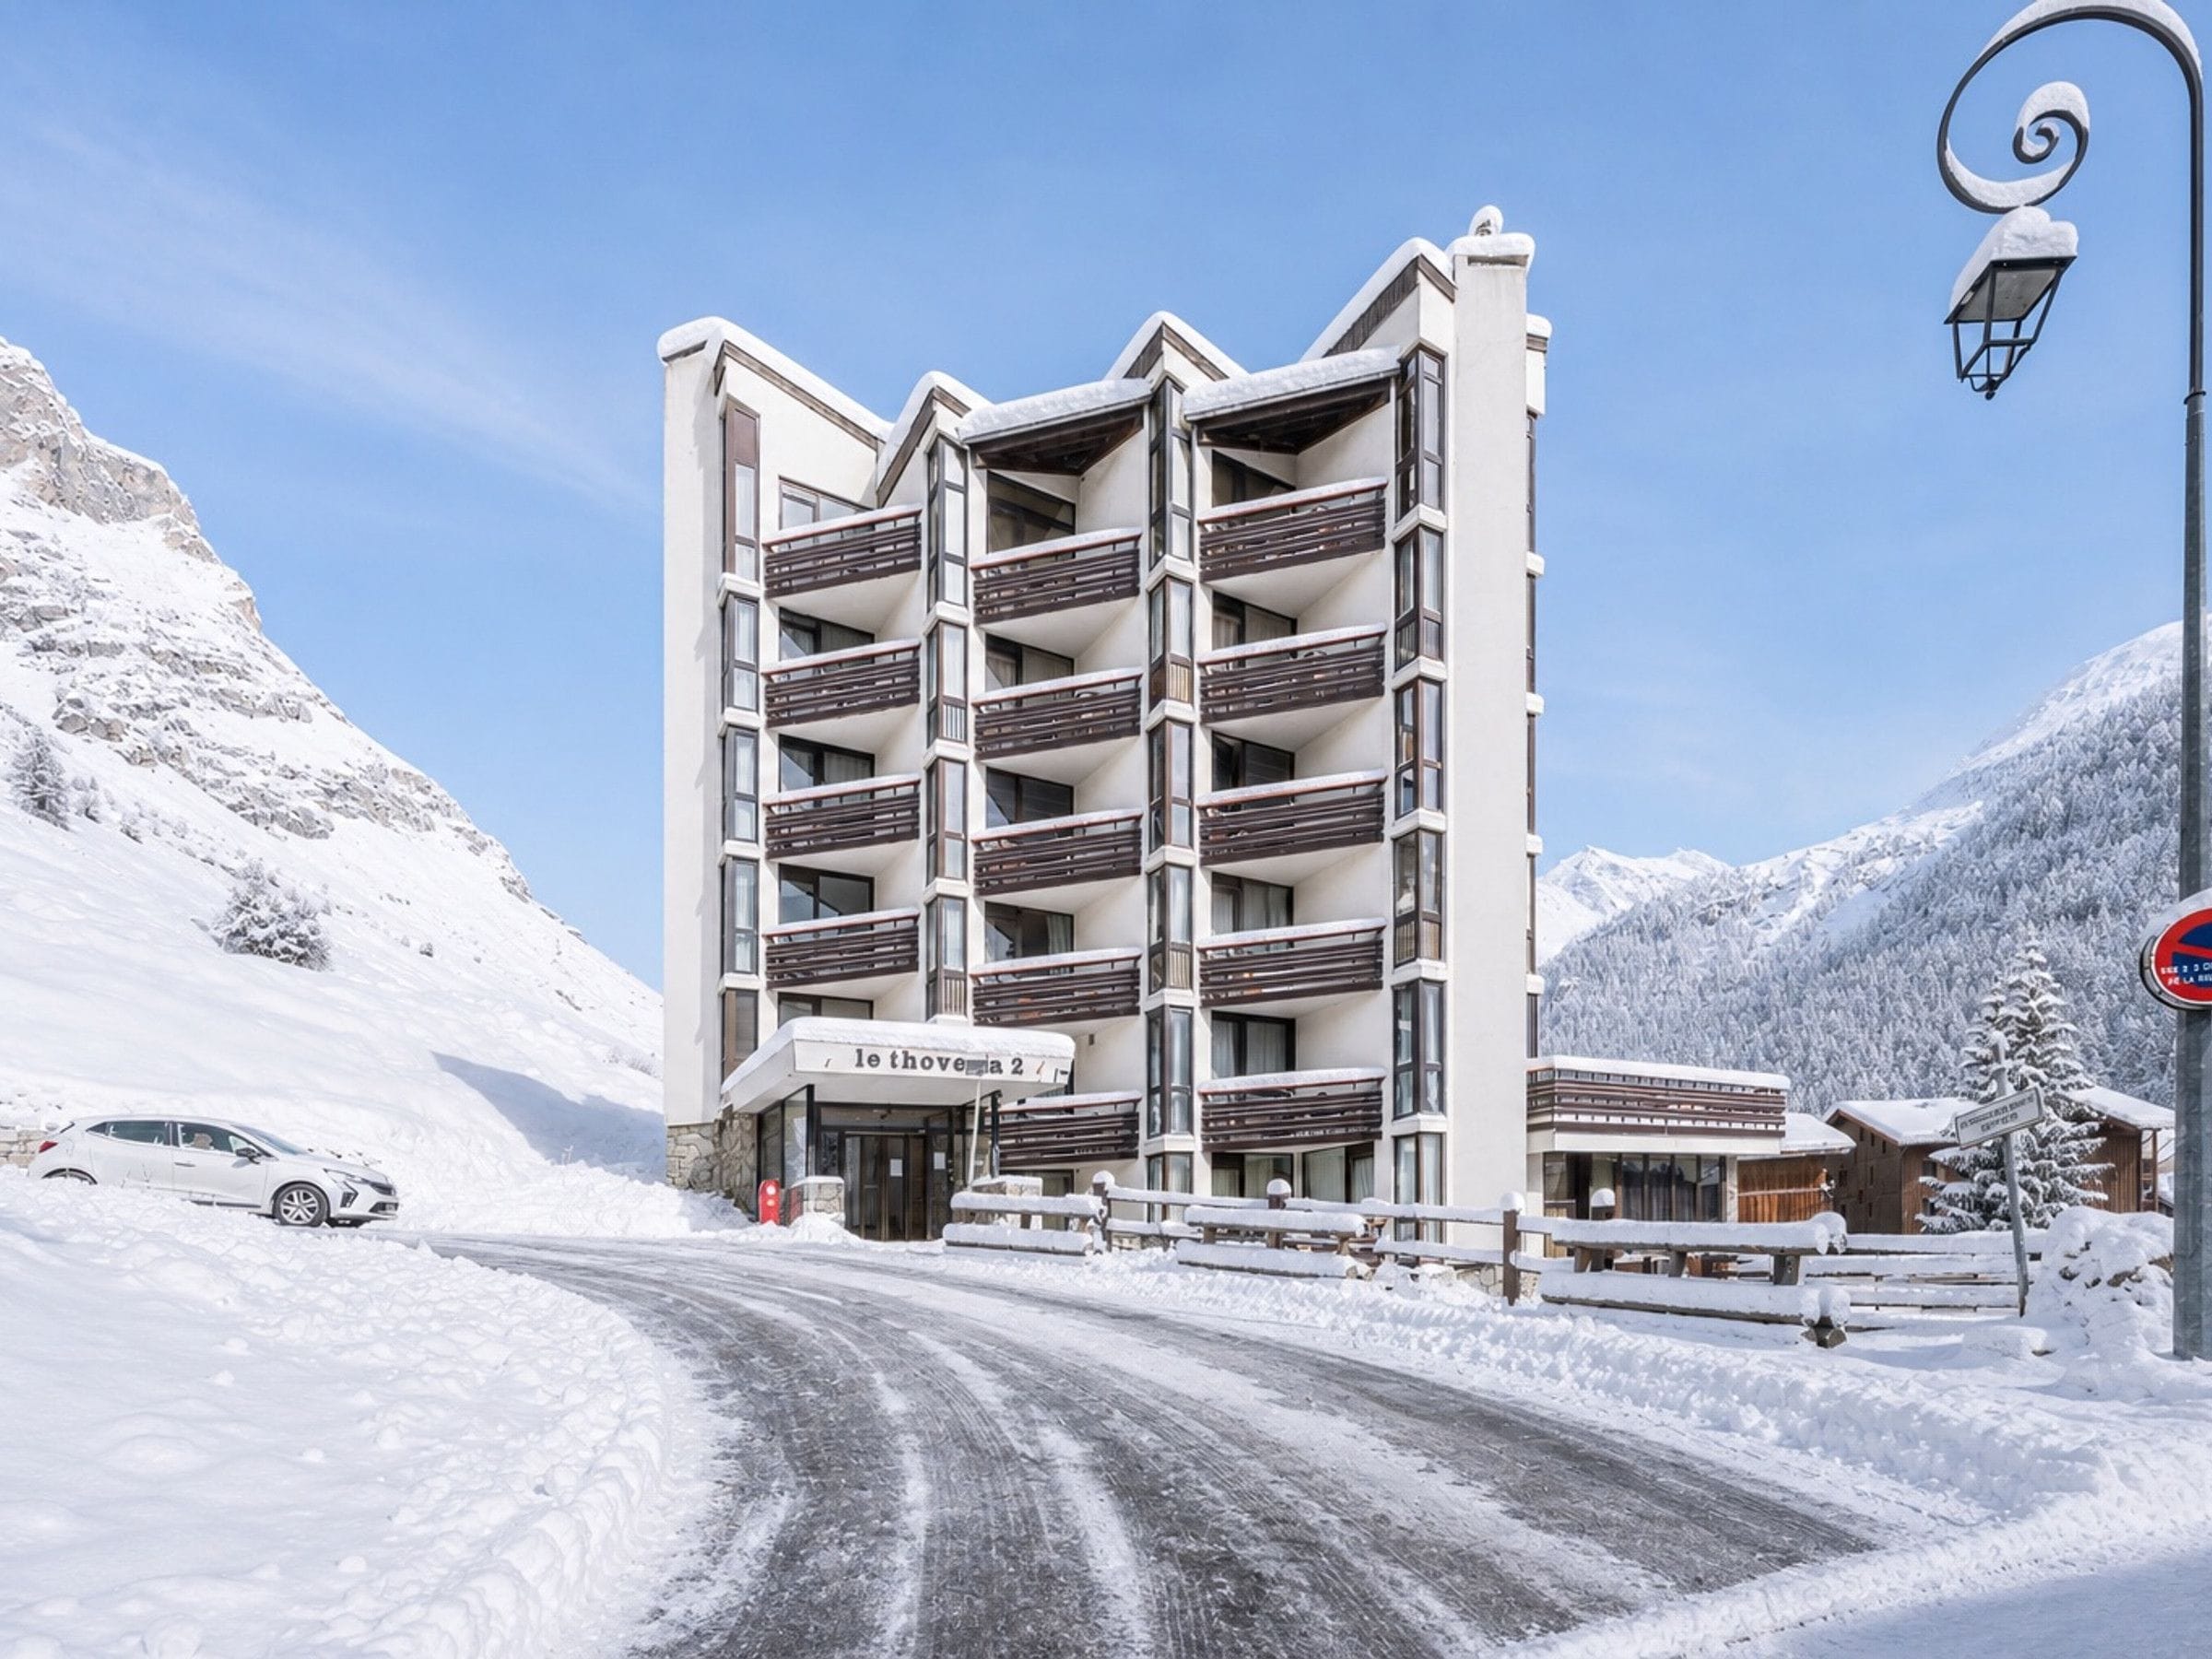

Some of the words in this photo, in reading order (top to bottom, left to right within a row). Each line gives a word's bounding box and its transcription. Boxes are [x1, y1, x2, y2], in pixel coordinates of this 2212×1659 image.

[855, 1048, 881, 1068] le
[889, 1050, 1004, 1076] thovea
[1011, 1057, 1024, 1076] 2
